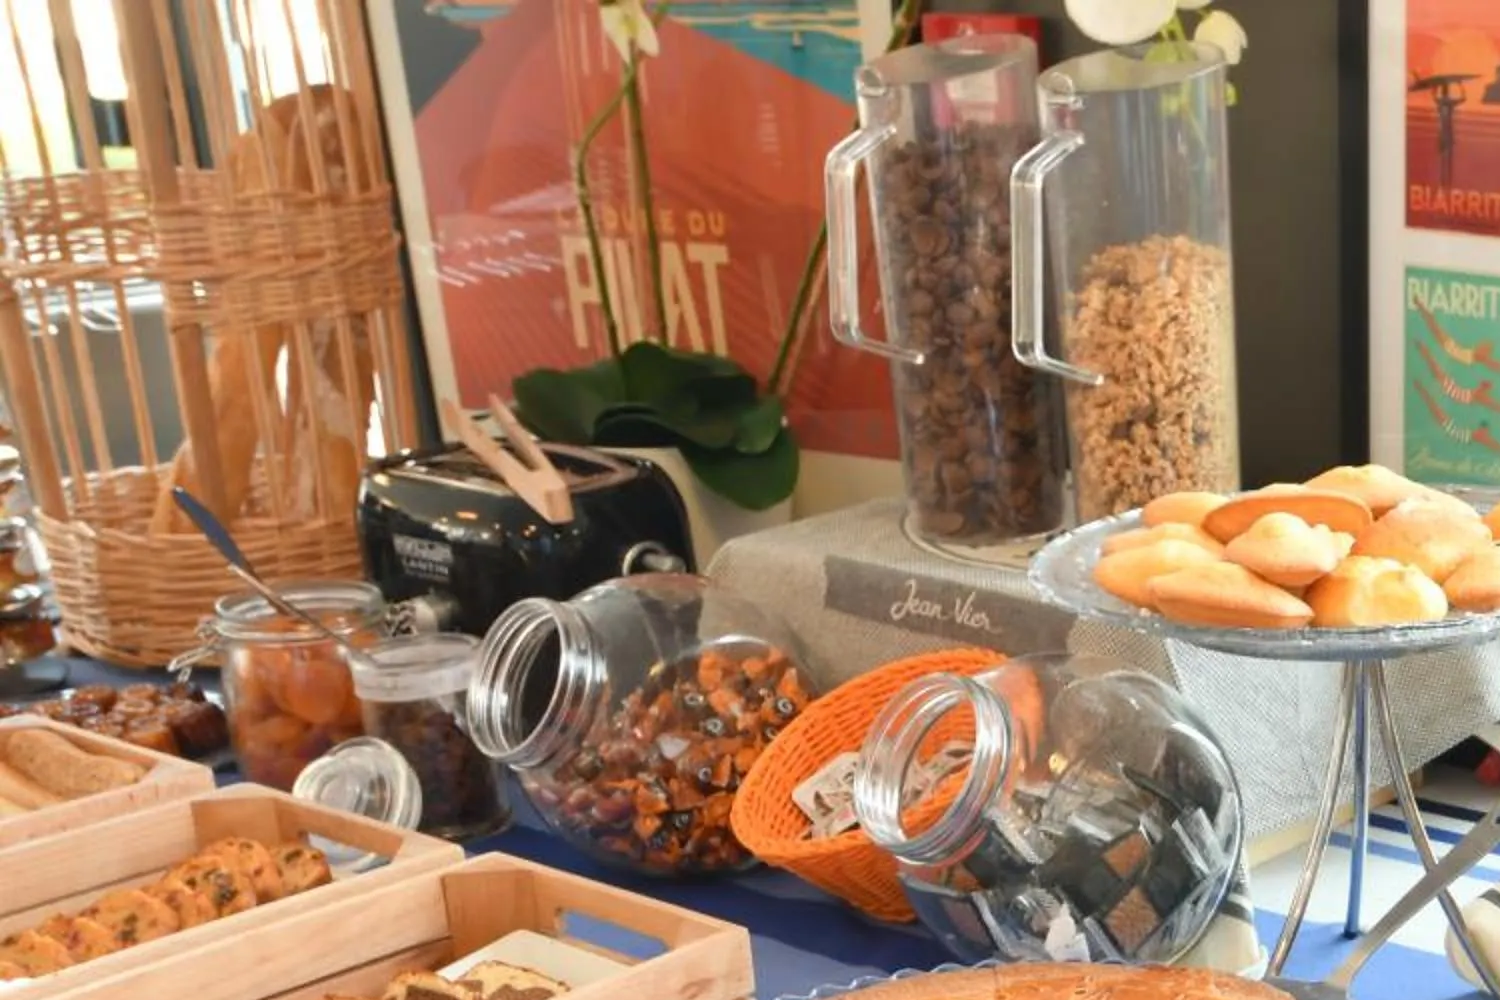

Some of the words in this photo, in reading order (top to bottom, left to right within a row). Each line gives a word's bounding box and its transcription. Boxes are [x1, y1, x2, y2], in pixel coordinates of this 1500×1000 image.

[602, 203, 677, 234] DUE
[687, 211, 726, 235] DU
[890, 579, 949, 621] Jean
[953, 591, 1002, 634] Vier
